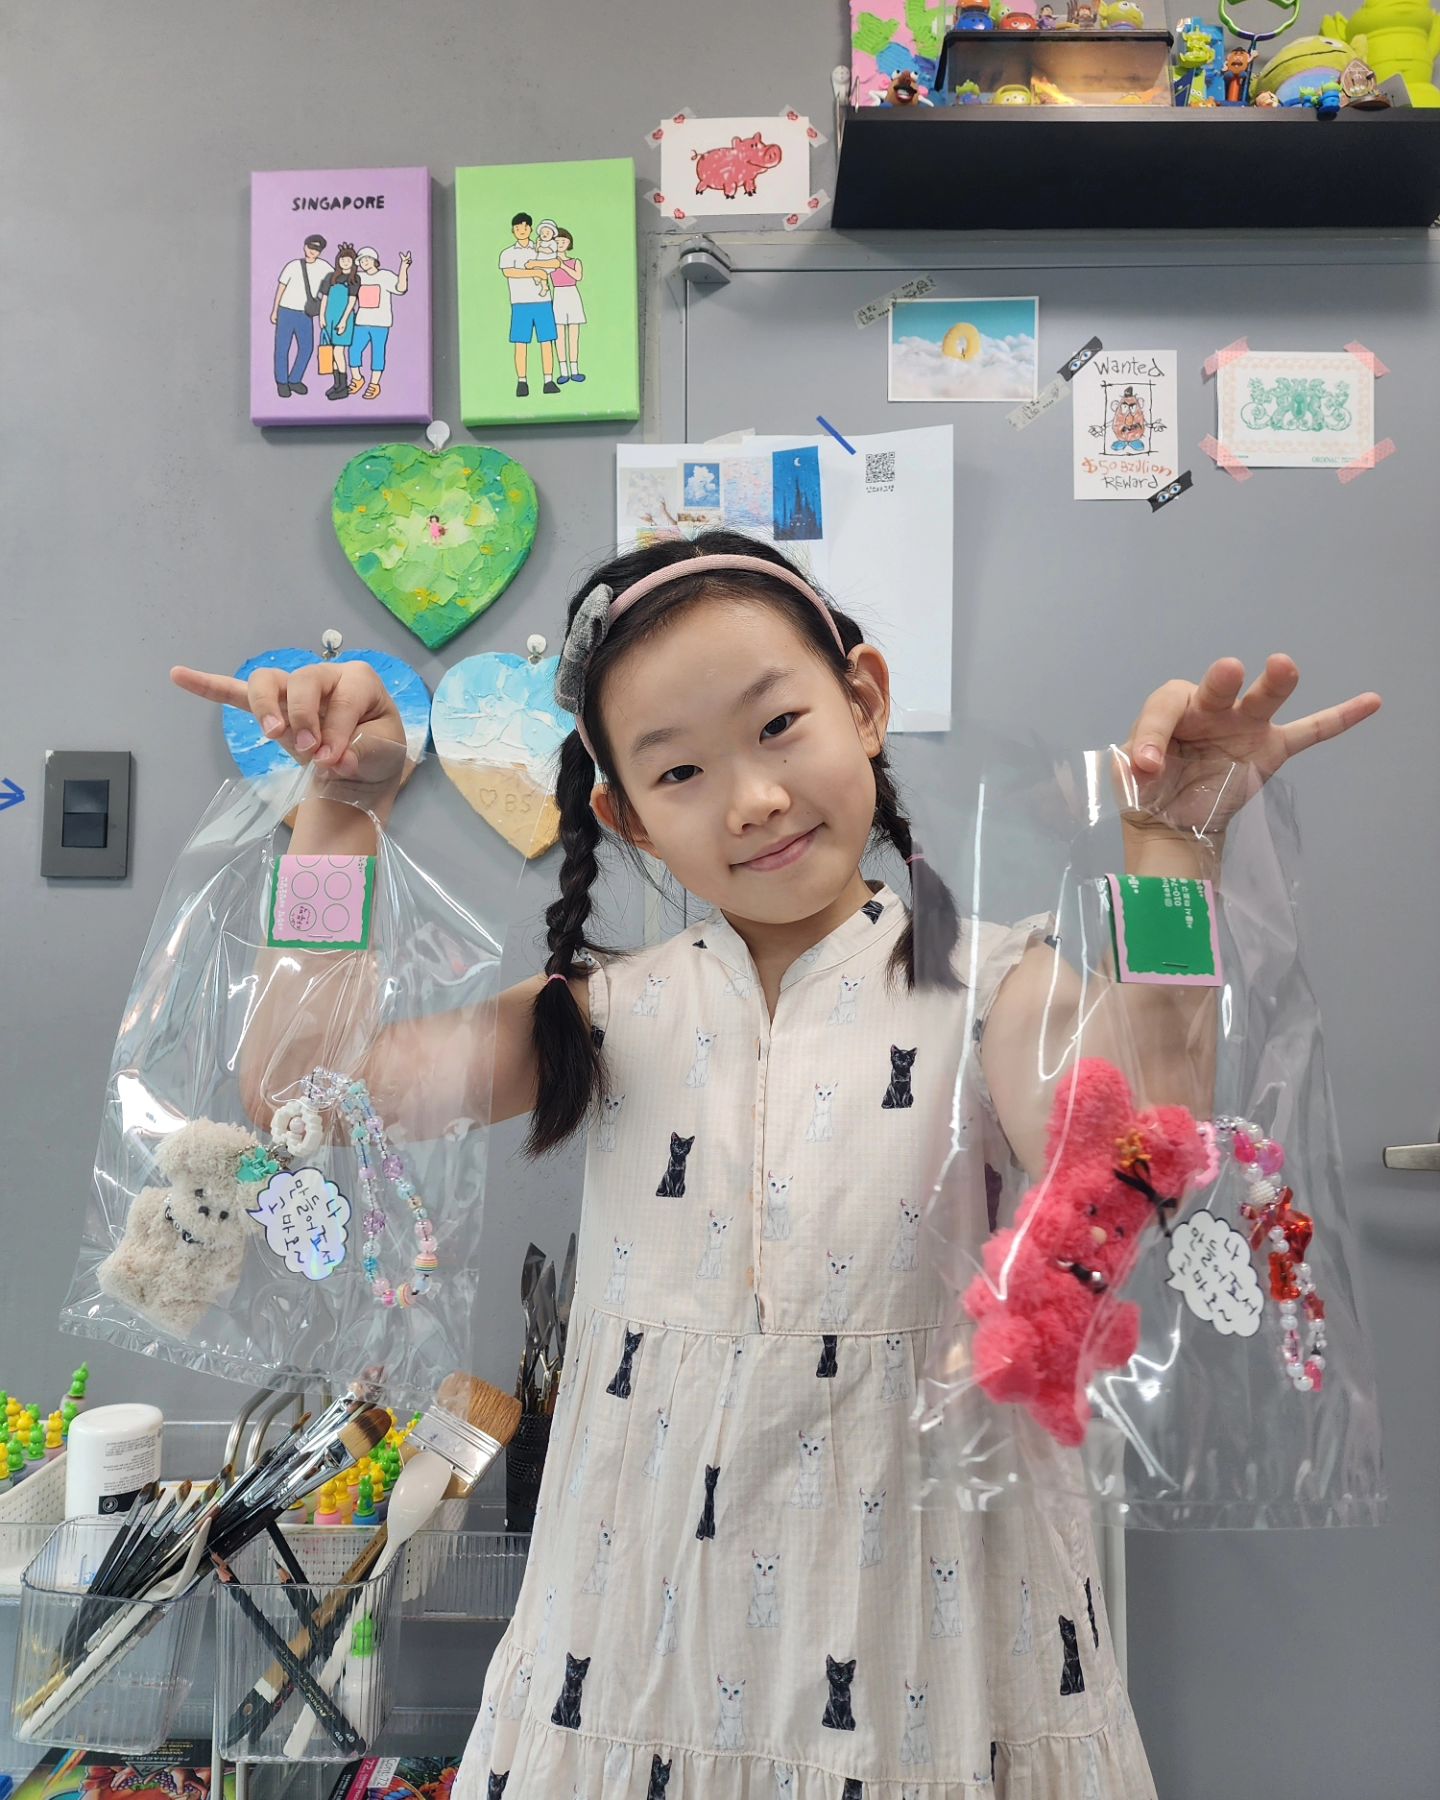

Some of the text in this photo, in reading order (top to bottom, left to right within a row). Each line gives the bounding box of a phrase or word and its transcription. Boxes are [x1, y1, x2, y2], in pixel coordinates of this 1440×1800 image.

[291, 195, 385, 211] SINGAPORE
[1094, 357, 1165, 377] Wanted
[325, 1198, 343, 1218] 나
[1223, 1237, 1239, 1260] 나
